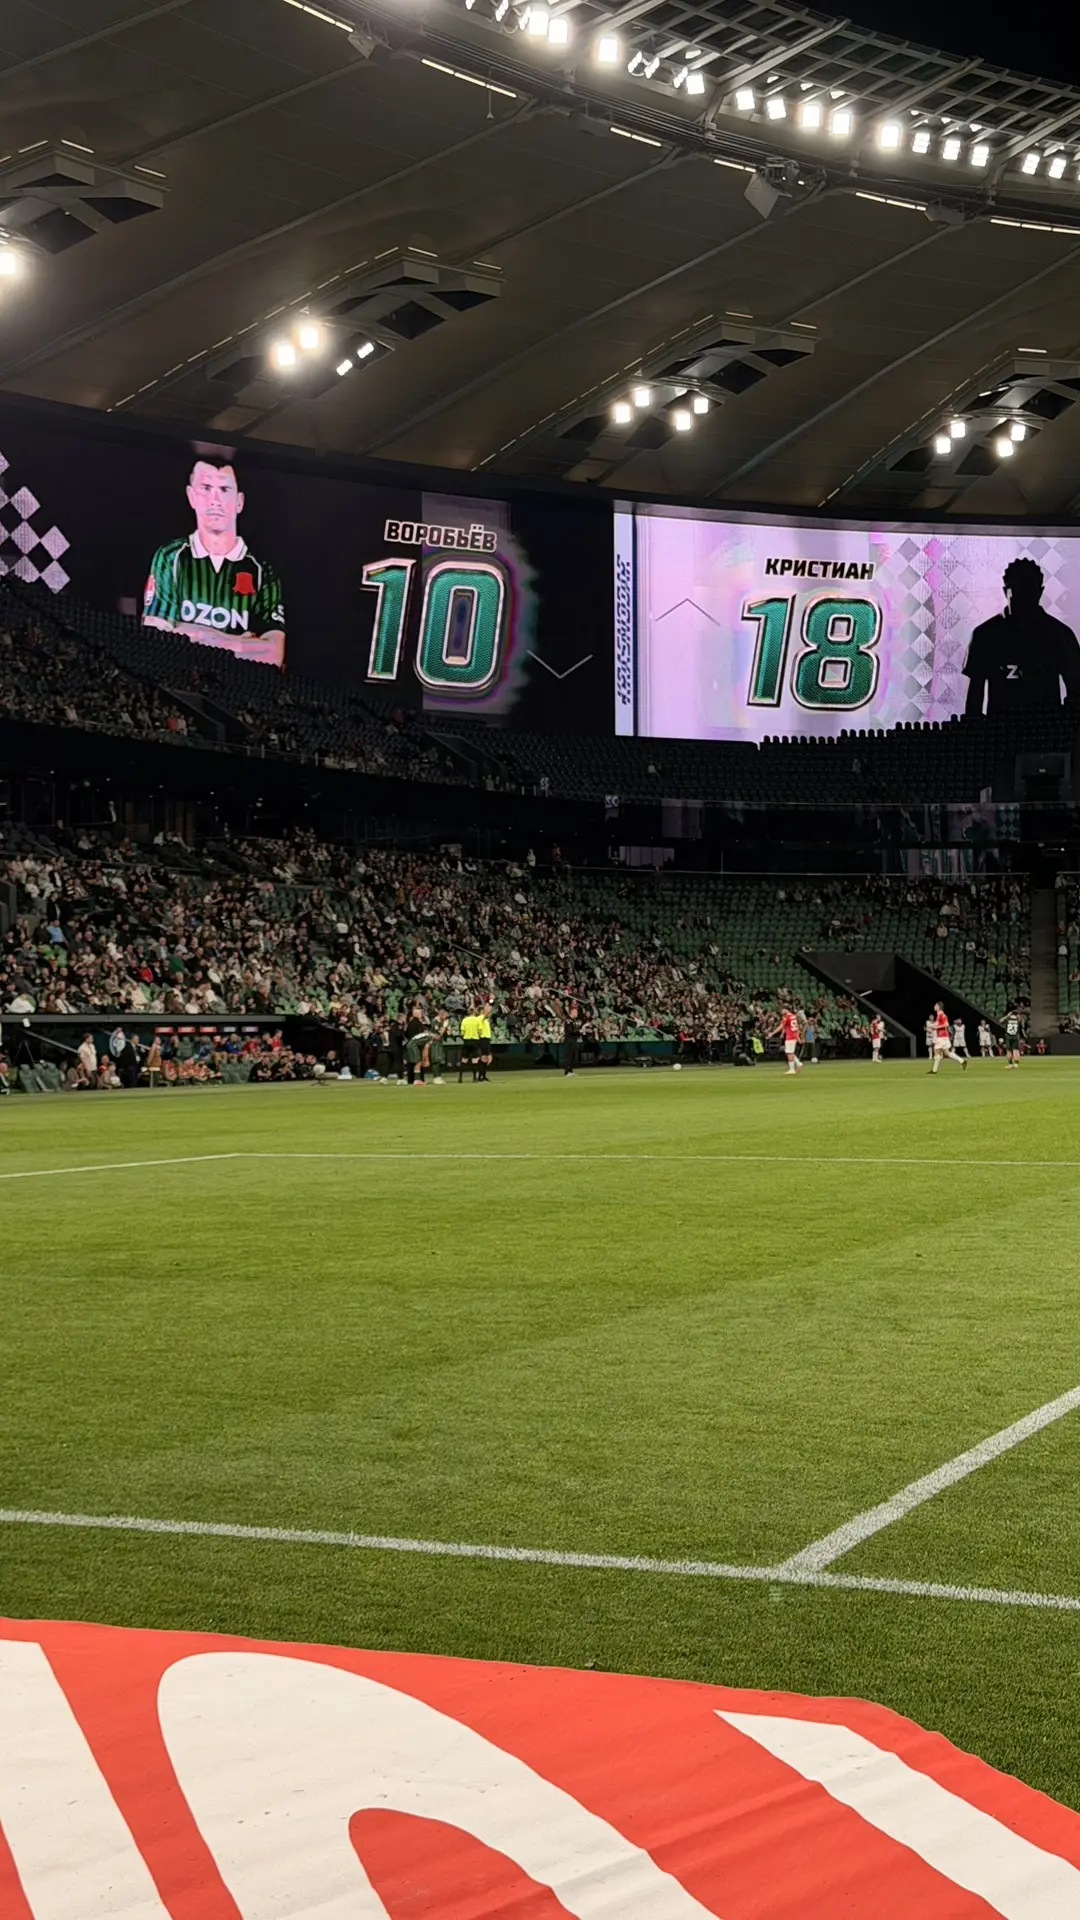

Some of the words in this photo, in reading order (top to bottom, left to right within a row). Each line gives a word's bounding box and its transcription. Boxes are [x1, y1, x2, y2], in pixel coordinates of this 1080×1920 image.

[384, 519, 497, 552] ВОРОБЬЁВ
[765, 558, 875, 580] КРИСТИАН
[181, 599, 249, 631] OZON
[361, 557, 505, 688] 10
[741, 594, 883, 712] 18
